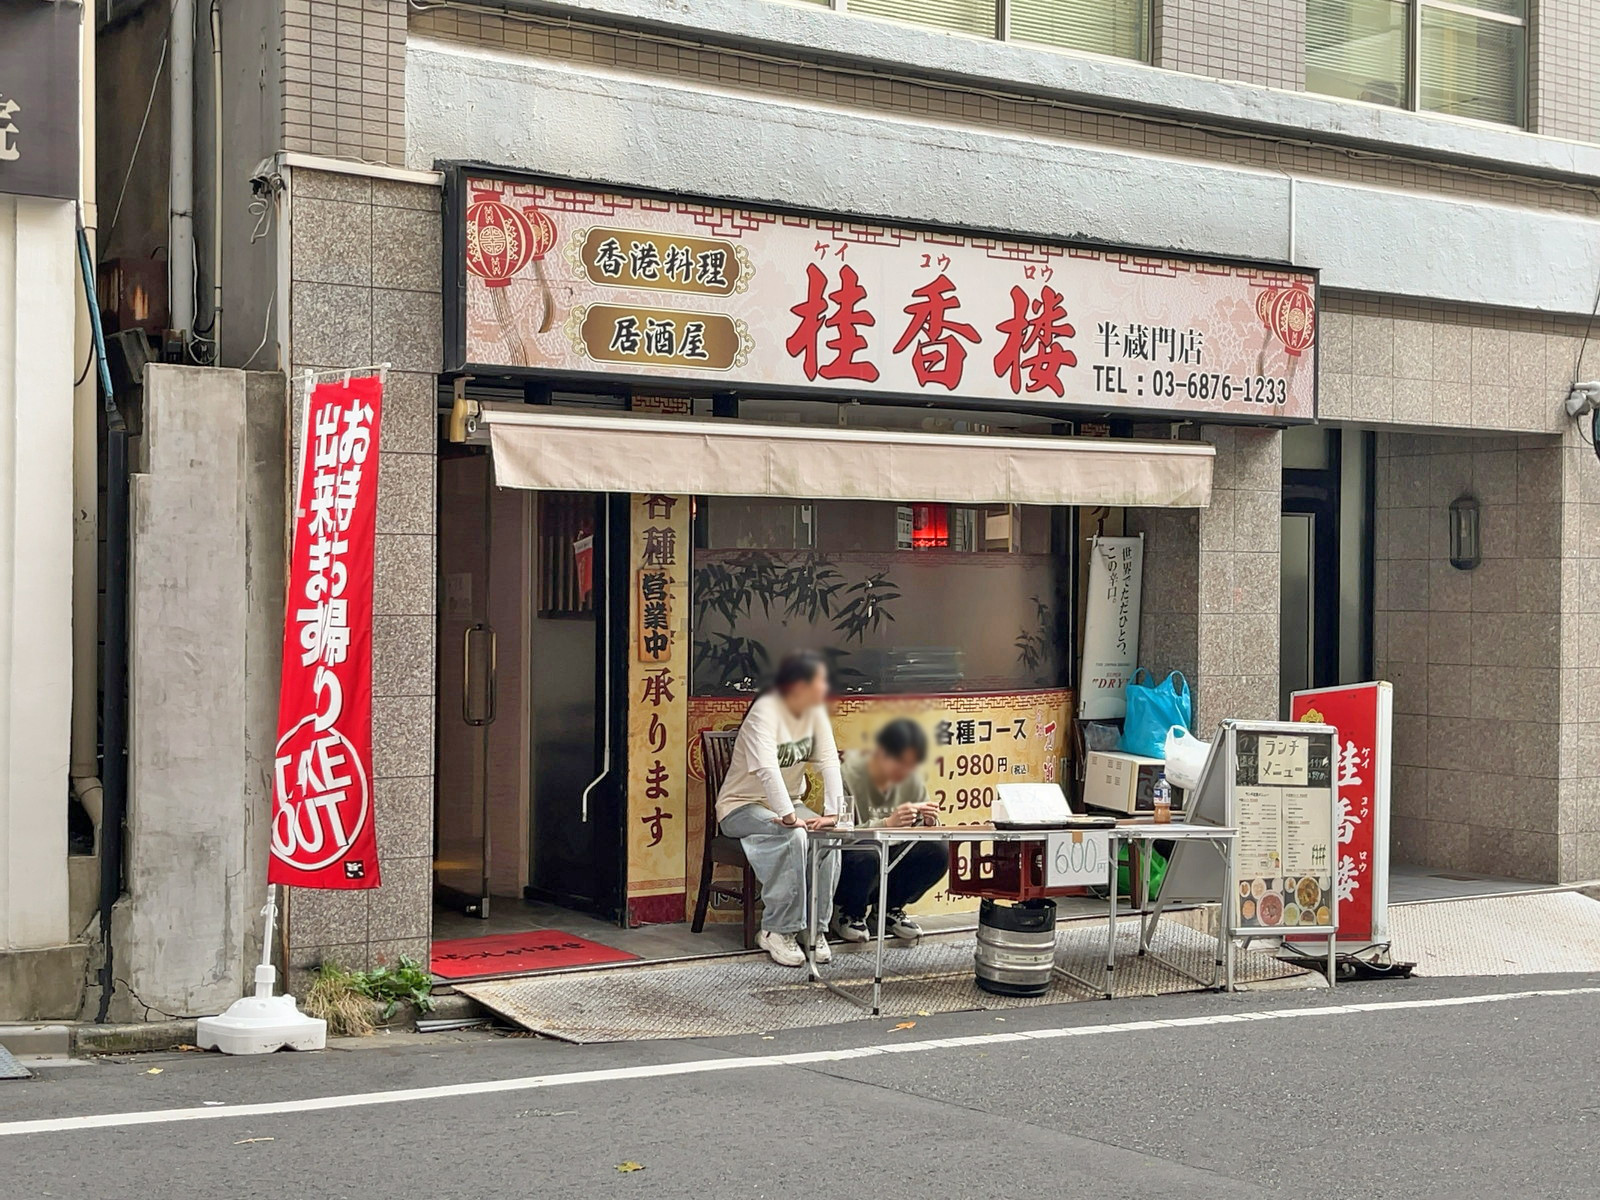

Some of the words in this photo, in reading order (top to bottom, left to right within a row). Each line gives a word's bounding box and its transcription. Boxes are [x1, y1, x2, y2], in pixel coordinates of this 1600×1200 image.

[595, 239, 728, 286] 香港料理
[814, 241, 849, 261] ケイ
[921, 253, 951, 272] コウ
[1023, 265, 1055, 282] ロウ
[609, 317, 709, 359] 居酒屋
[786, 262, 1077, 398] 桂香楼
[1093, 321, 1204, 365] 半蔵門店
[1152, 372, 1287, 405] 03-6876-1233
[296, 402, 342, 668] 出来ます
[642, 572, 669, 659] 営業中
[935, 718, 1027, 745] 各種コース
[1265, 740, 1299, 756] ランチ
[1263, 761, 1303, 778] メニュー
[272, 790, 349, 857] OUT
